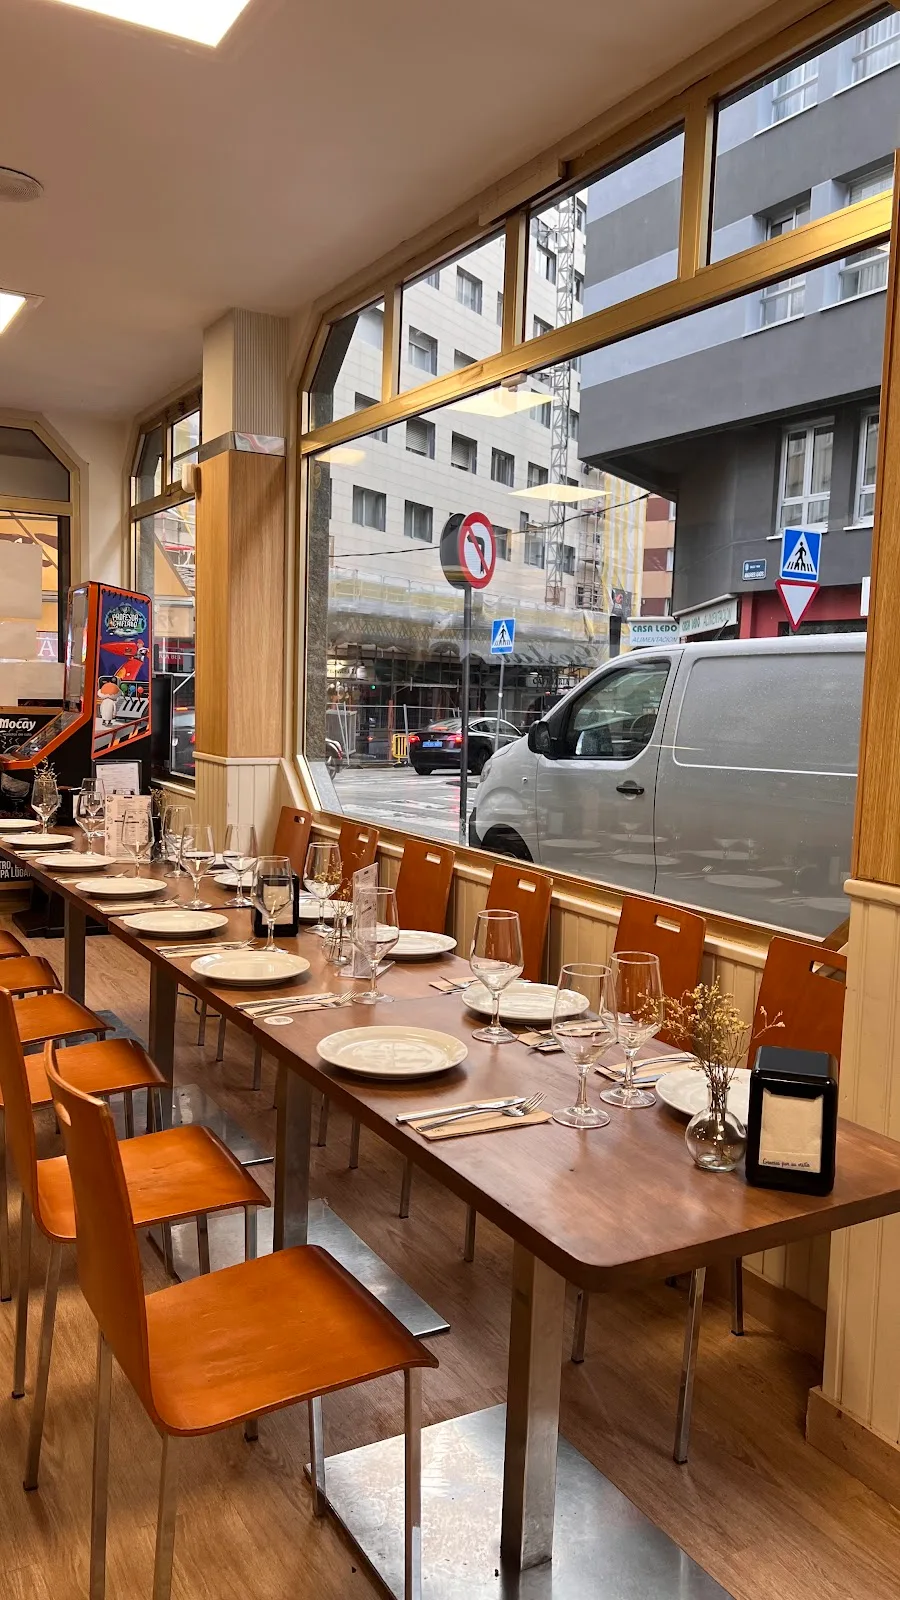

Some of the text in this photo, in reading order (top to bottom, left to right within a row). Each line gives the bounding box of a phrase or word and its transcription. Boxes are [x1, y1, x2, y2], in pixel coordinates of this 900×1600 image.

[632, 624, 677, 633] CASA LEDO
[0, 718, 37, 731] Mocay
